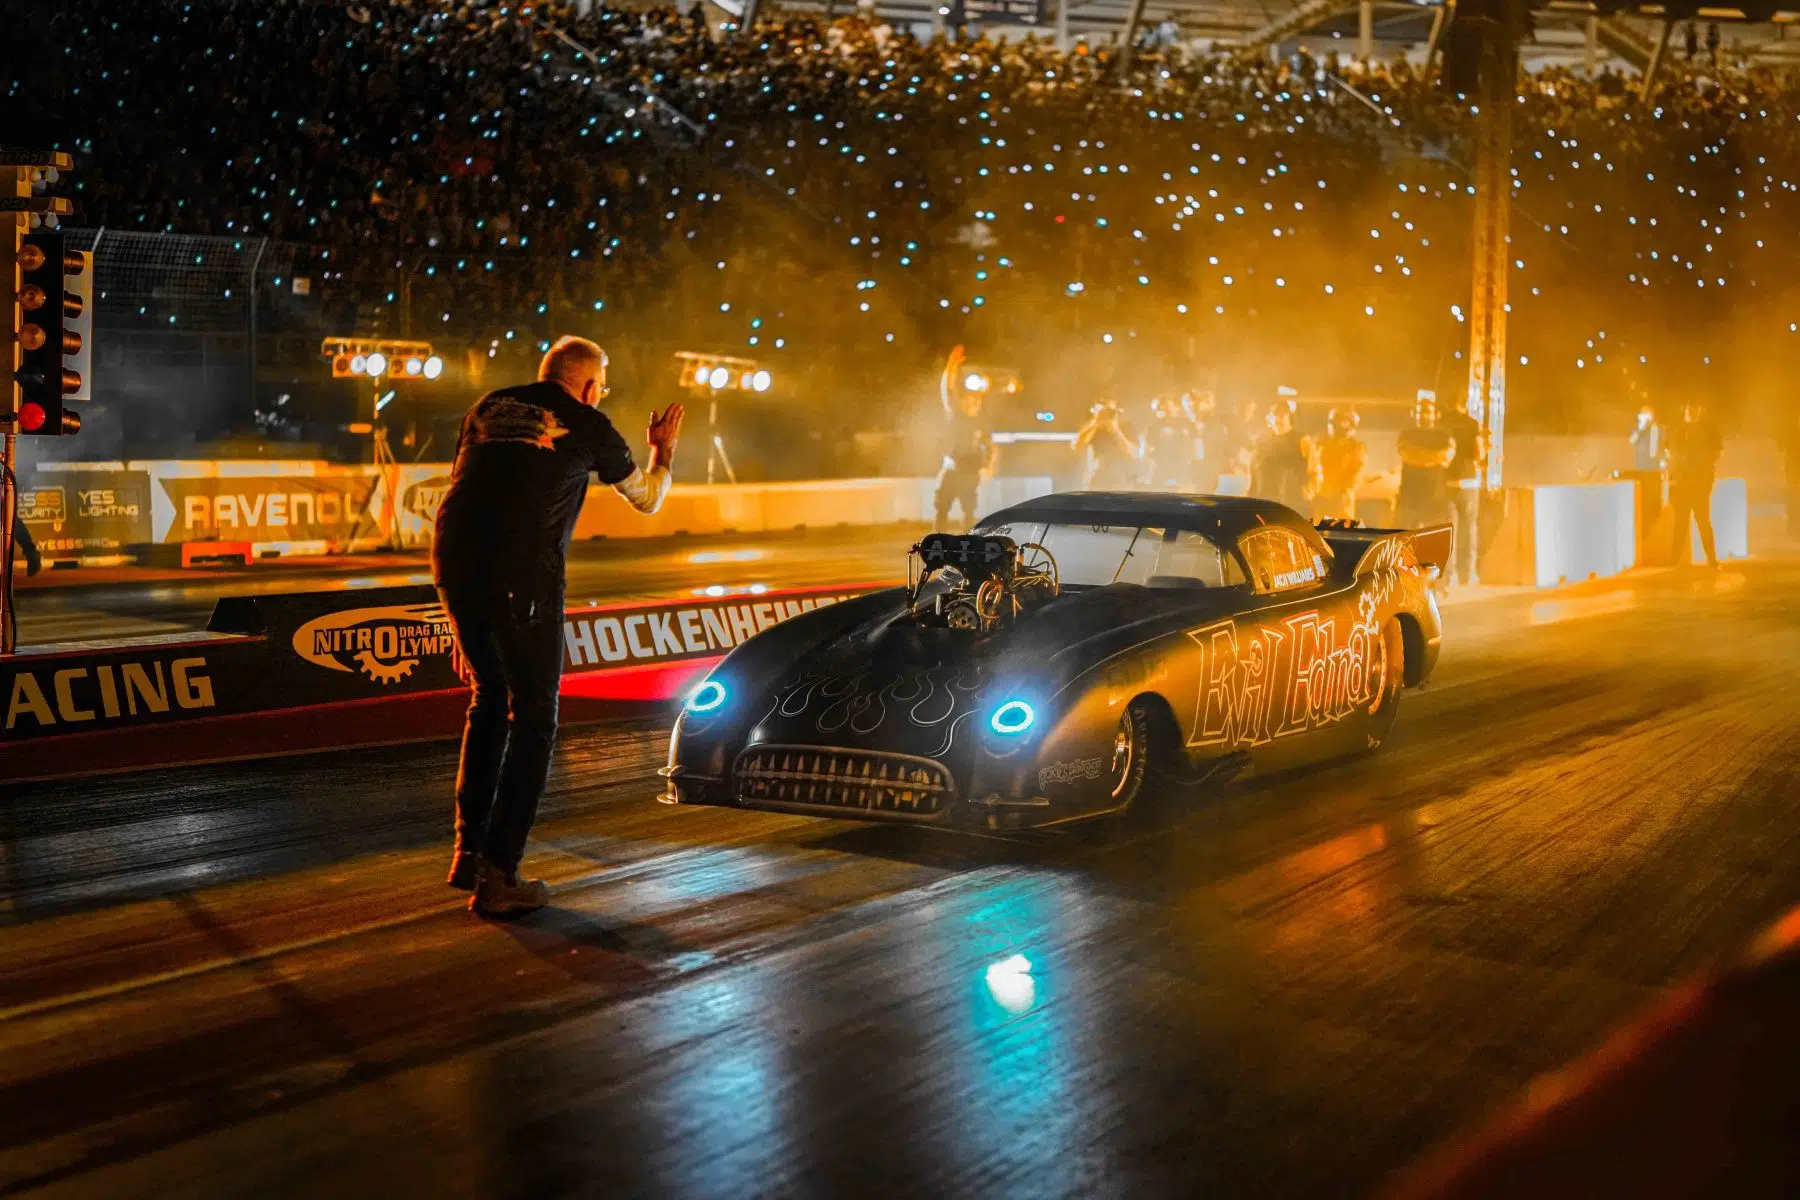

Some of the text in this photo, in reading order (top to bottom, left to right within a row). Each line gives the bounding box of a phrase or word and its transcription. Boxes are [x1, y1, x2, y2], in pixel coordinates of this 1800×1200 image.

[78, 489, 115, 505] YES
[17, 507, 61, 519] CURITY
[79, 504, 139, 517] LIGHTING
[184, 492, 362, 529] RAVENOL
[399, 624, 430, 638] DRAG
[6, 657, 215, 729] ACING
